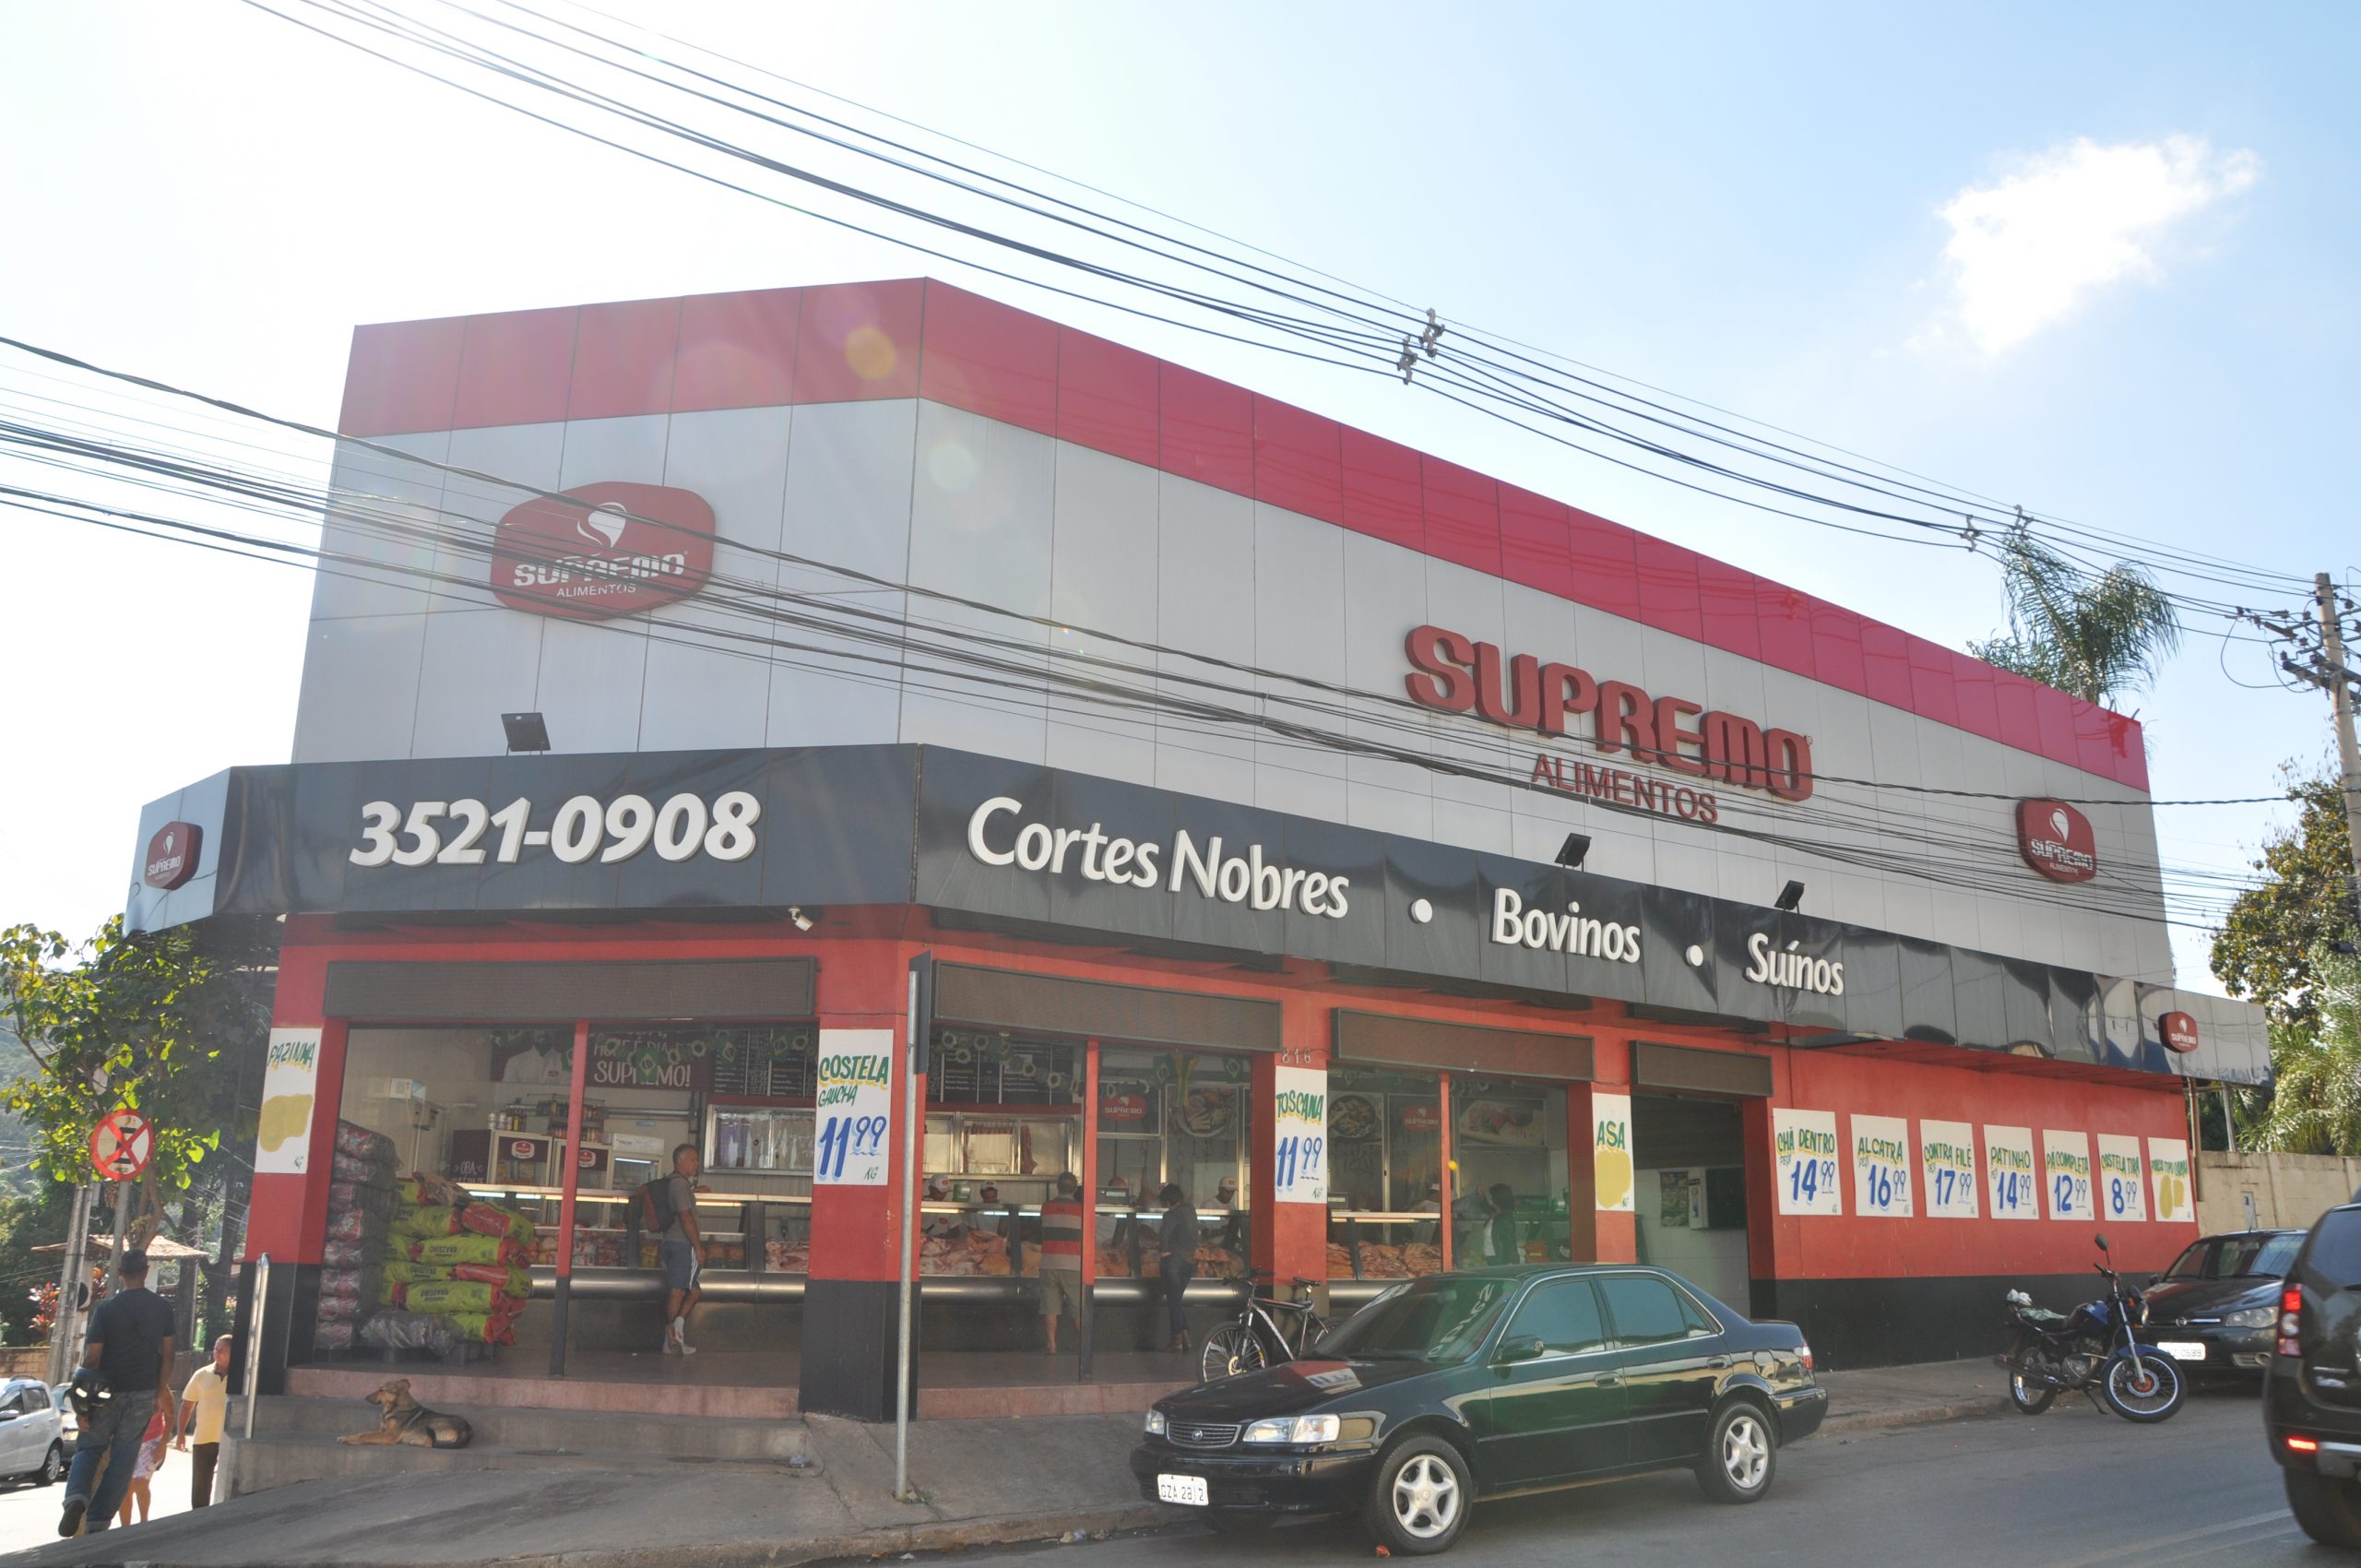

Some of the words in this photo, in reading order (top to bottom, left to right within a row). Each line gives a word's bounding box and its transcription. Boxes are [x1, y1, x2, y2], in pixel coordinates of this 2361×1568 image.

[513, 552, 685, 587] SUPREMO
[556, 583, 636, 598] ALIMENTOS
[1404, 624, 1812, 802] SUPREMO
[1532, 754, 1718, 825] ALIMENTOS
[349, 790, 762, 867] 3521-0908
[148, 855, 183, 876] SUPREMO
[967, 797, 1159, 888] Cortes
[1168, 829, 1350, 919] Nobres
[1490, 887, 1641, 964] Bovinos
[1744, 932, 1844, 995] Suínos
[1282, 1048, 1311, 1064] 816
[594, 1061, 691, 1087] SUPMO!
[818, 1054, 890, 1087] COSTELA
[818, 1084, 859, 1107] GAUCHA
[1276, 1089, 1324, 1122] TOSCANA
[1596, 1121, 1625, 1150] ASA
[1798, 1128, 1835, 1155] DENTRO
[1858, 1136, 1904, 1164] ALCATRA
[1924, 1143, 1953, 1167] CONTRA
[1990, 1146, 2031, 1169] PATINHO
